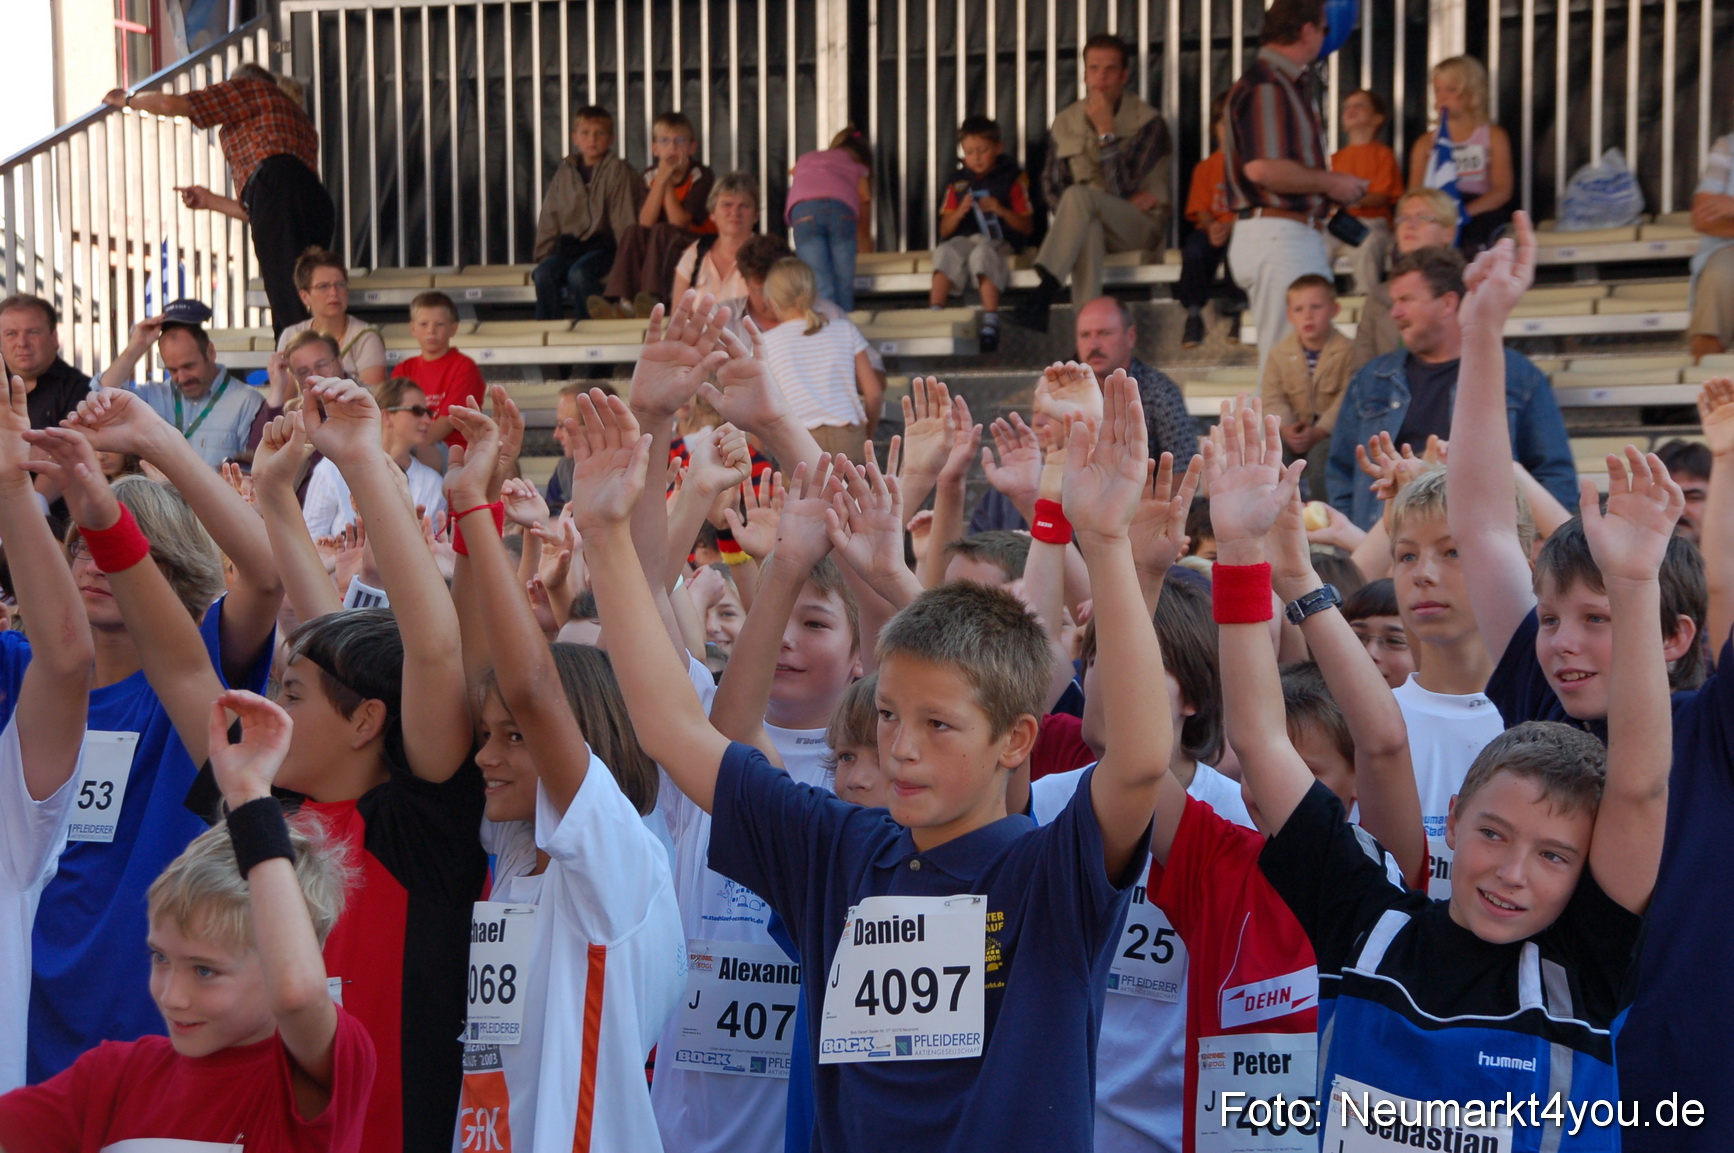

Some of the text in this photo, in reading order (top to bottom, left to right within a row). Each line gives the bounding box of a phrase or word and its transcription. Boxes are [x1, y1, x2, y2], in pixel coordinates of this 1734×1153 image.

[72, 823, 114, 835] PFLEIDERER
[853, 913, 925, 947] Daniel
[1122, 923, 1176, 965] 25
[831, 963, 841, 989] J
[1121, 974, 1178, 994] PFLEIDERER
[688, 989, 701, 1010] J
[854, 965, 971, 1016] 4097
[1245, 986, 1292, 1013] DEHN
[479, 1022, 520, 1034] PFLEIDERER
[716, 1000, 796, 1041] 407
[821, 1036, 876, 1055] BOCK
[914, 1032, 981, 1048] PFLEIDERER
[675, 1049, 732, 1066] BOCK
[914, 1046, 981, 1057] AKTIENGESELLSCHAFT
[1478, 1051, 1537, 1073] hummel
[1233, 1051, 1292, 1076] Peter
[1204, 1090, 1216, 1112] J
[461, 1107, 504, 1151] GfK
[1364, 1106, 1499, 1153] Sebastian
